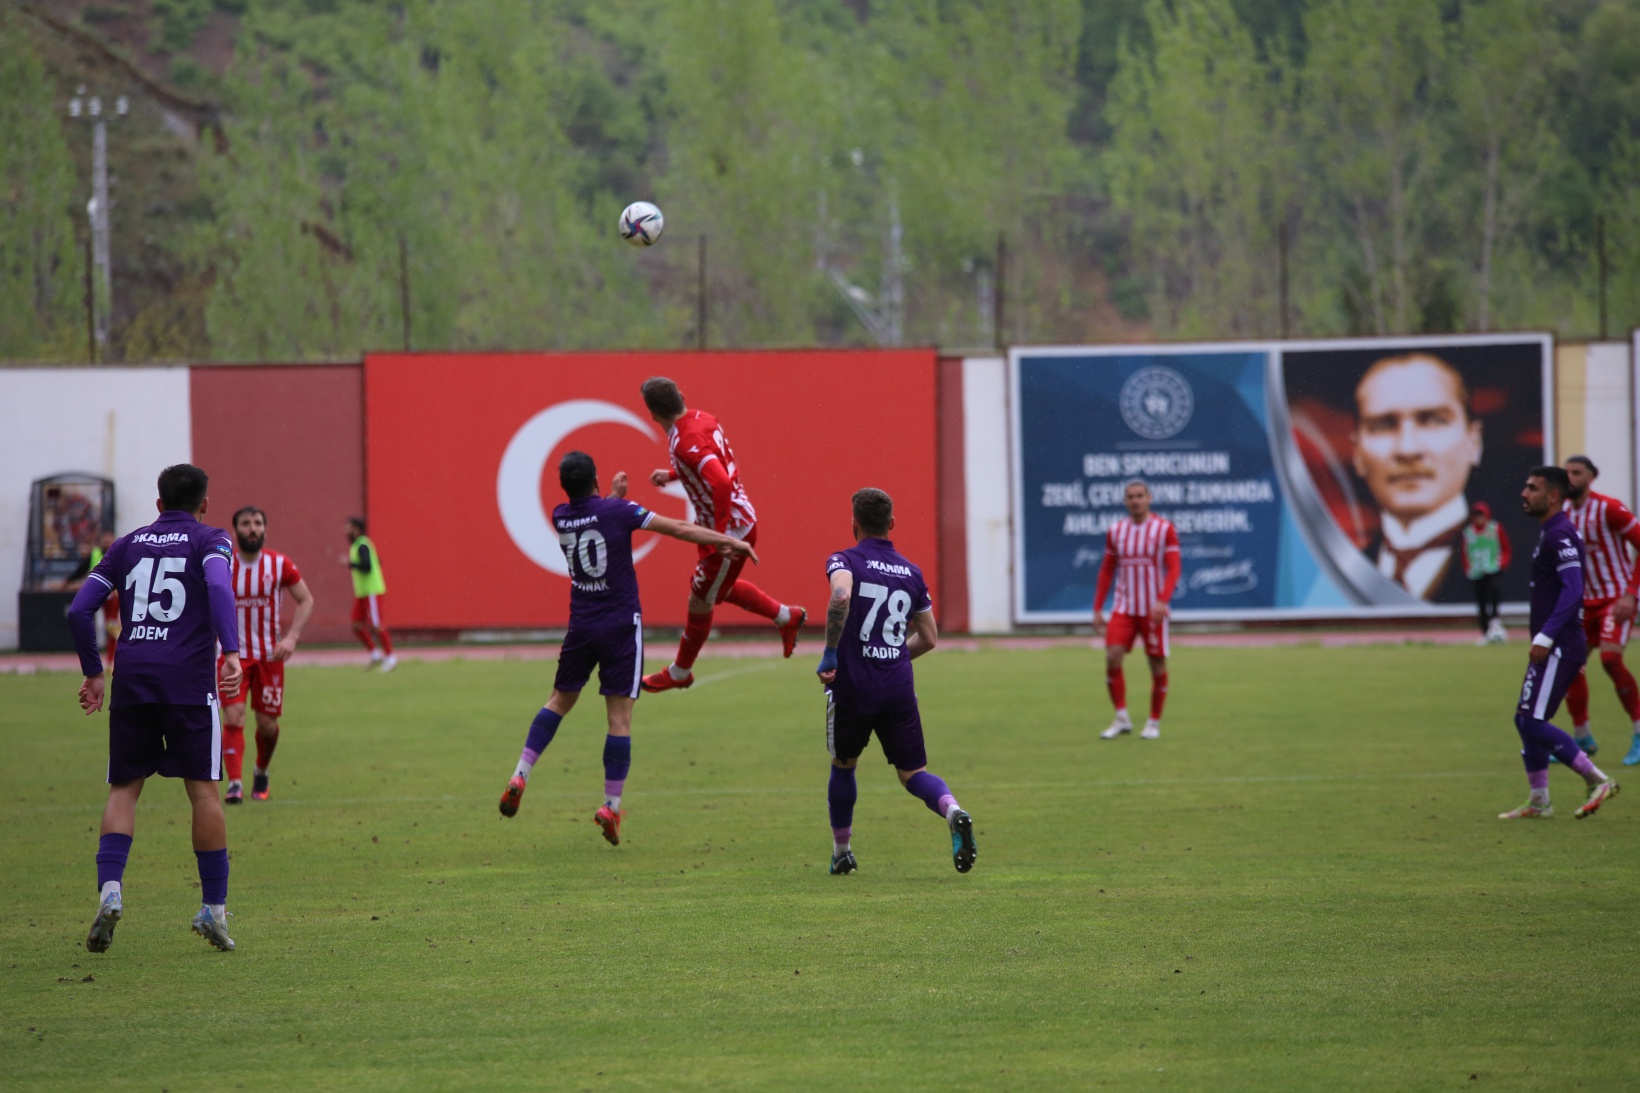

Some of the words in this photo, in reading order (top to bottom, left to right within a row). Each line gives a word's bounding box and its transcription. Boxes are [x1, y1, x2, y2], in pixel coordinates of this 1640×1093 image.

[1083, 453, 1121, 477] BEN
[1122, 451, 1230, 476] SPORCUNUN
[1186, 479, 1273, 502] ZAMANDA
[558, 515, 598, 529] KARMA
[138, 532, 189, 544] KARMA
[558, 530, 607, 577] 70
[870, 560, 911, 576] KARMA
[125, 557, 187, 622] 15
[858, 581, 912, 647] 78
[1603, 615, 1615, 633] 5
[129, 625, 169, 641] ADEM
[261, 685, 283, 707] 53
[1522, 680, 1534, 702] 6
